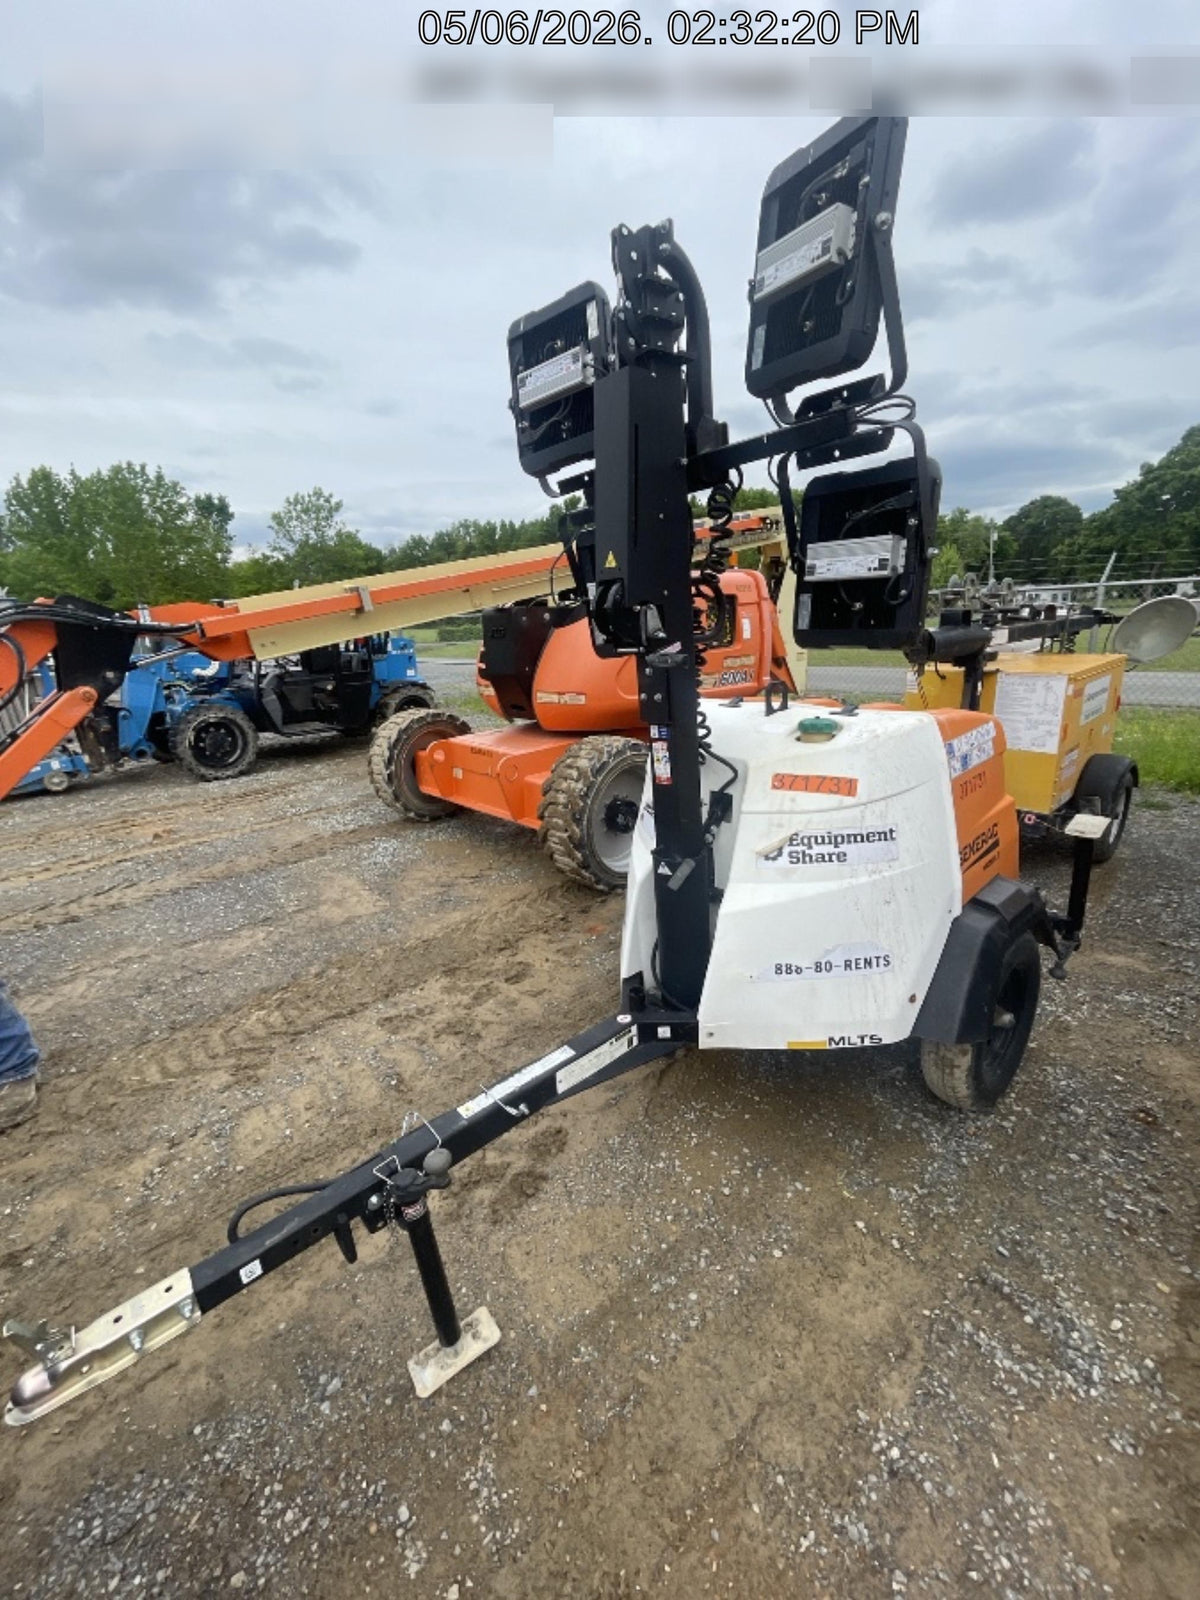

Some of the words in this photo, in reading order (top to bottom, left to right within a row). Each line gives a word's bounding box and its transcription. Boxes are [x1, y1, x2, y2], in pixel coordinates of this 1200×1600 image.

[772, 772, 857, 796] 371731
[787, 827, 896, 850] Equipment
[788, 850, 847, 865] Share
[828, 1034, 882, 1047] MLTS
